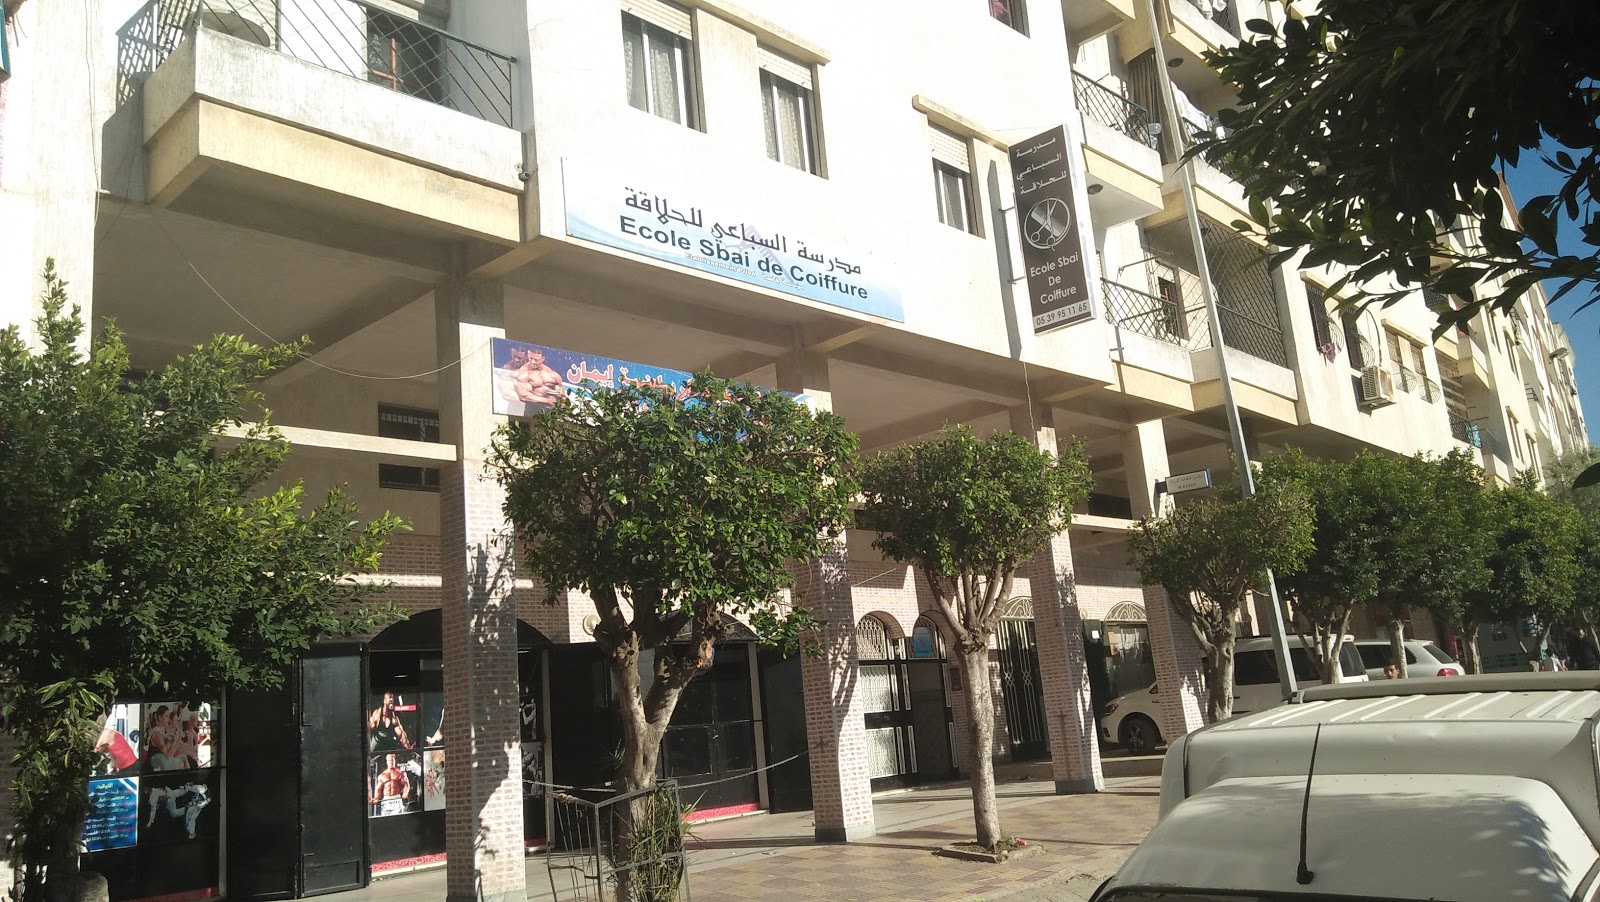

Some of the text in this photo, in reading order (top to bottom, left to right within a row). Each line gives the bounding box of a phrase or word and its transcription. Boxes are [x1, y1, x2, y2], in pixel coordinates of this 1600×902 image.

[1016, 137, 1056, 157] مدرسة
[1016, 152, 1062, 181] السباعي
[1020, 170, 1067, 195] للحلاقة
[625, 187, 861, 275] مدرسة السباعي للحلاقة
[620, 215, 868, 299] Ecole Sbai de Coiffure
[1030, 251, 1079, 277] Ecole Sbai
[1048, 276, 1061, 287] De
[1040, 286, 1077, 304] Coiffure
[1036, 302, 1087, 326] 05 39 95 11 65
[566, 361, 614, 388] إيمان
